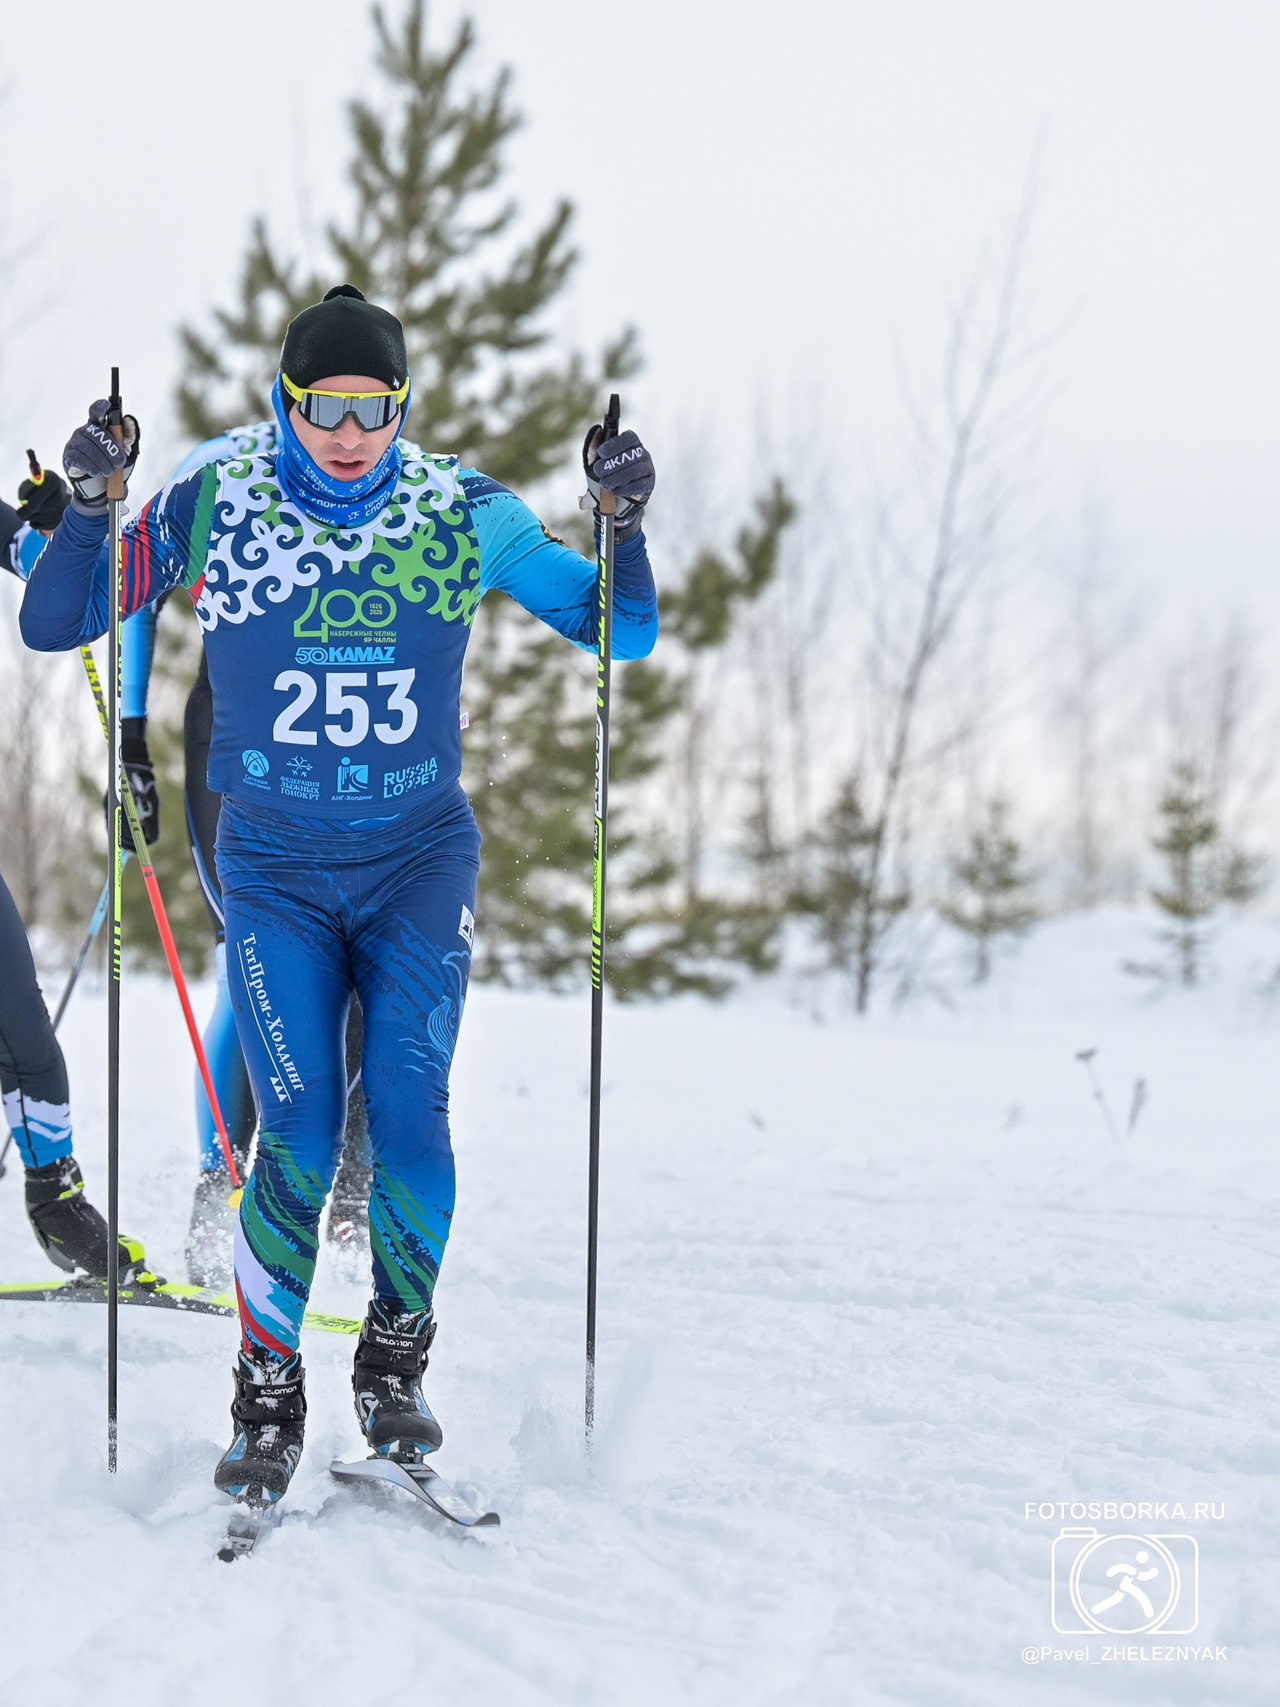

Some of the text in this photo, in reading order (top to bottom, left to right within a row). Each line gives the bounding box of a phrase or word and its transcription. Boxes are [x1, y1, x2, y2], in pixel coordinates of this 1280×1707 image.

[603, 447, 643, 470] 4KAAD
[365, 491, 391, 517] СПОРТА
[293, 588, 397, 643] 400
[295, 646, 396, 665] 50 KAMAZ
[272, 667, 419, 747] 253
[280, 776, 320, 788] ФЕДЕРАЦИЯ
[383, 757, 438, 786] RUSSIA
[280, 782, 320, 794] ЛЫЖНЫХ
[281, 787, 320, 801] ГОНОК РТ
[242, 932, 305, 1092] ТатПром-Холдинг
